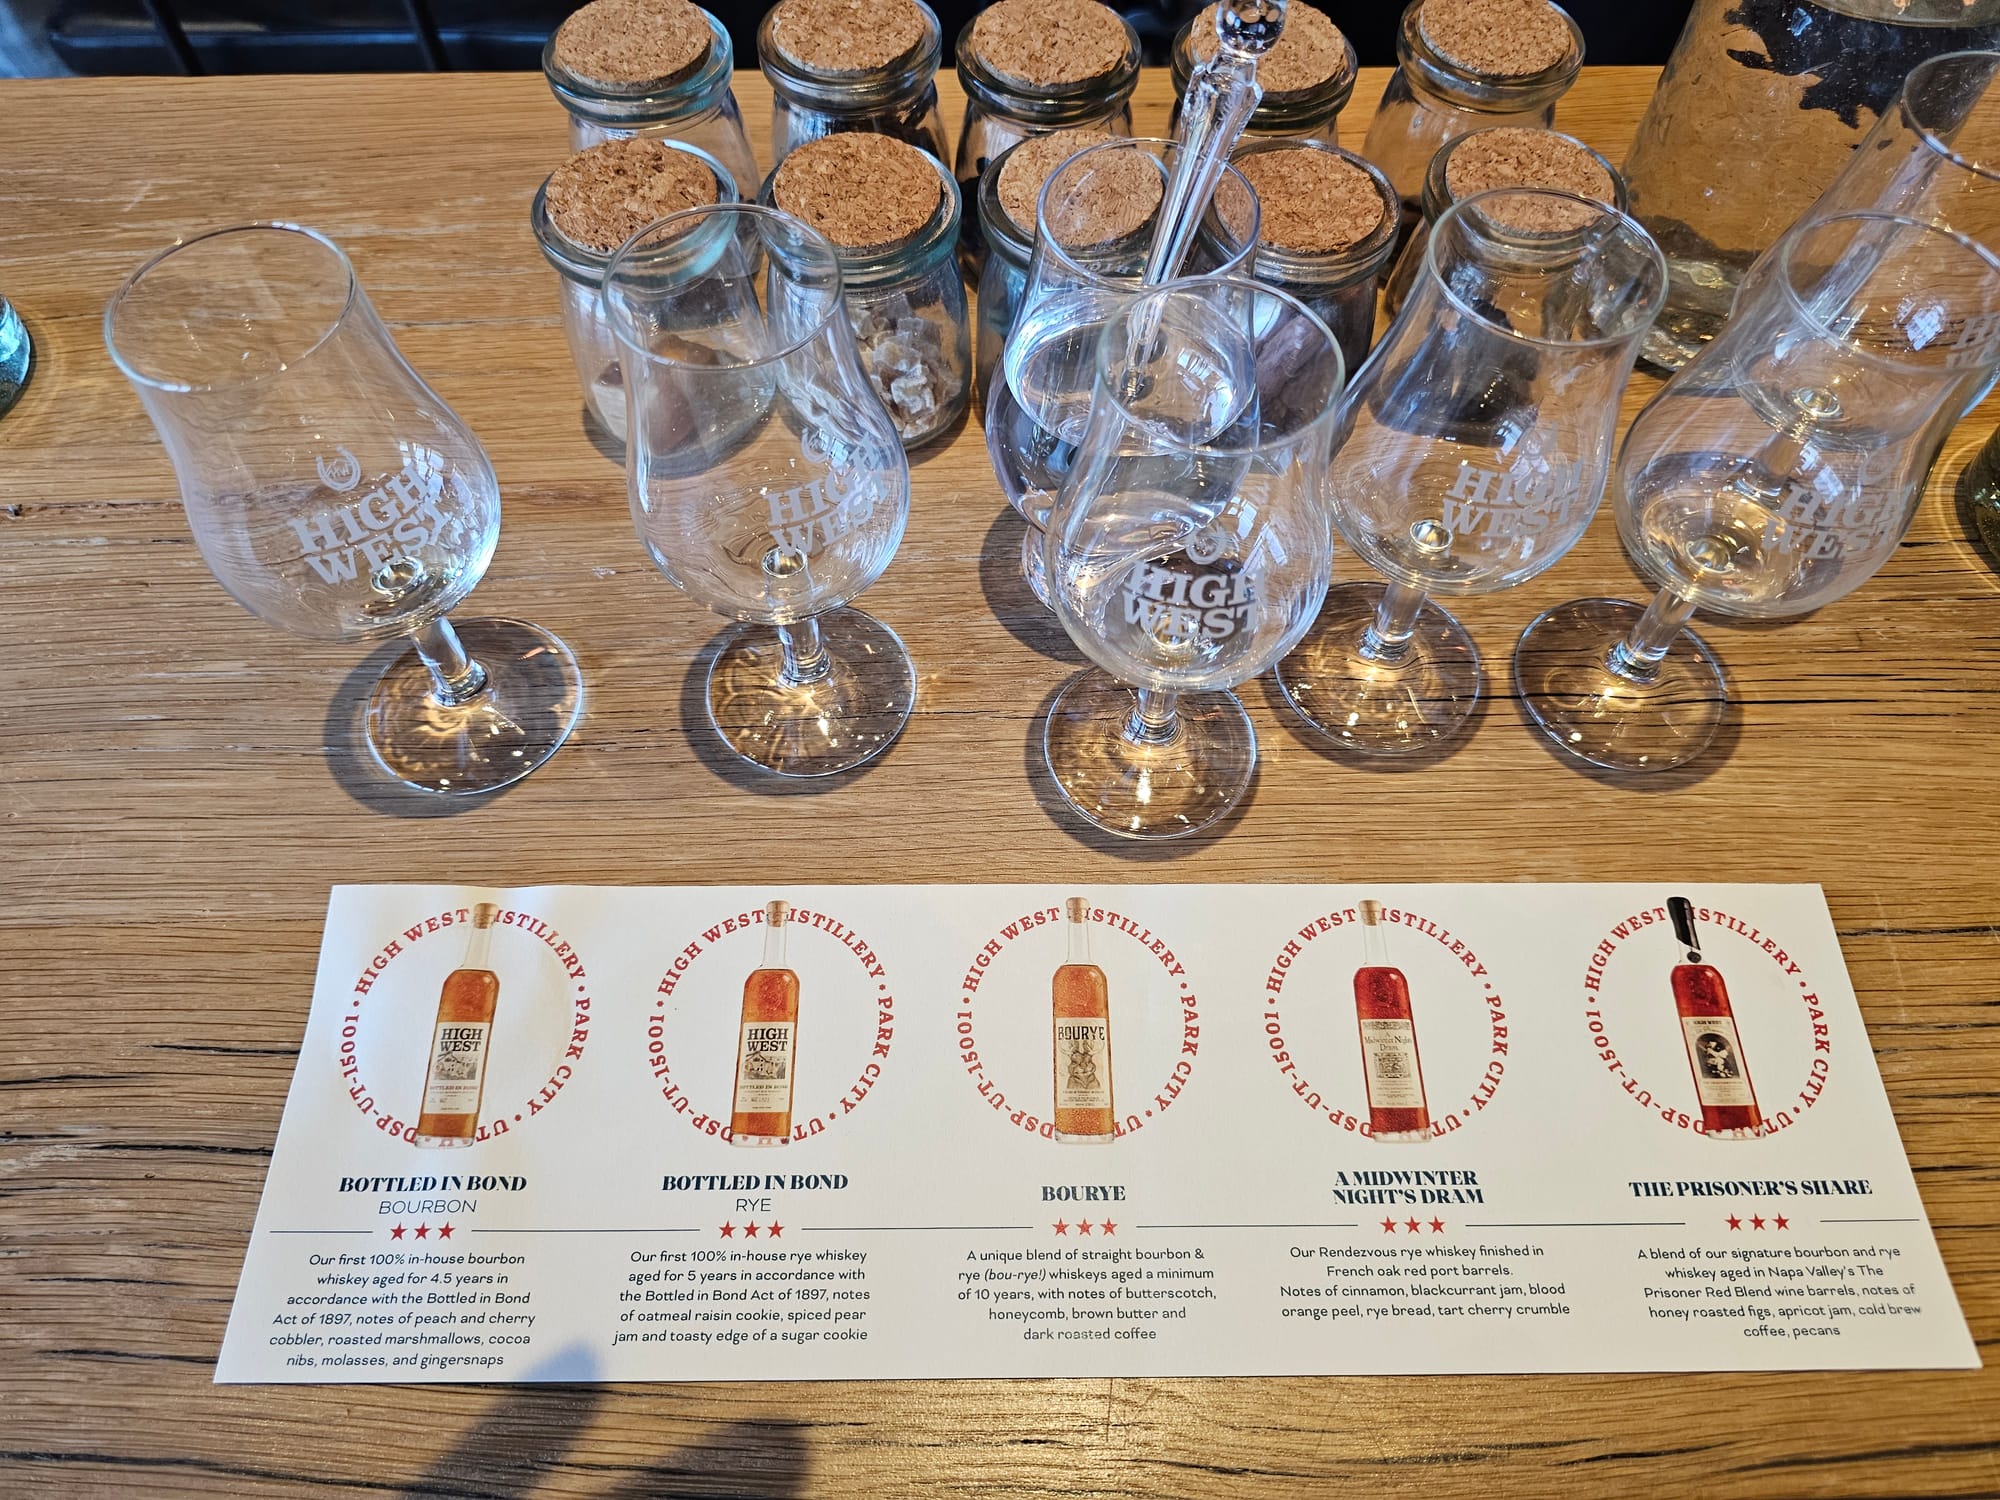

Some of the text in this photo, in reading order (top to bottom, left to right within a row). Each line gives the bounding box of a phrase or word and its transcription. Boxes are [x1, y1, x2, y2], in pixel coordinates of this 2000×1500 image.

[1446, 459, 1585, 507] HIGH
[287, 464, 430, 554] HIGH
[1442, 489, 1575, 538] WEST
[304, 496, 453, 585] WEST
[1125, 559, 1266, 609] HIGH
[1122, 590, 1258, 639] WEST
[354, 909, 469, 994] HIGH WEST
[658, 909, 765, 995] HIGH WEST
[963, 907, 1060, 992] HIGH WEST
[1266, 909, 1356, 993] HIGH WEST
[1584, 907, 1666, 991] HIGH WEST
[441, 1028, 484, 1041] HIGH
[747, 1027, 789, 1041] HIGH
[1058, 1025, 1105, 1041] BOURYE
[440, 1040, 482, 1052] WEST
[747, 1040, 788, 1052] WEST
[1155, 995, 1201, 1111] PARK CITY
[1472, 996, 1509, 1110] PARK CITY
[1800, 993, 1831, 1108] PARK CITY
[528, 998, 591, 1115] PARK CITY
[841, 997, 895, 1114] PARK CITY
[338, 1175, 527, 1192] BOTTLED IN BOND
[661, 1174, 848, 1191] BOTTLED IN BOND
[1335, 1170, 1479, 1186] A MIDWINTER
[1042, 1185, 1126, 1201] BOURYE
[1332, 1188, 1484, 1205] NIGHT'S DRAM
[1628, 1179, 1873, 1197] THE PRISONER'S SHARE
[378, 1199, 477, 1214] BOURBON
[736, 1198, 772, 1212] RYE
[309, 1252, 525, 1265] Our first 100% in-house bourbon
[630, 1249, 867, 1265] Our first 100% in-house rye whiskey
[966, 1247, 1205, 1264] A unique blend of straight bourbon &
[1290, 1244, 1544, 1261] Our Rendezvous rye whiskey finished in
[1638, 1245, 1901, 1262] A blend of our signature bourbon and rye
[628, 1268, 865, 1286] aged for 5 years in accordance with
[958, 1267, 1214, 1285] rye (bou-rye!) whiskeys aged a minimum
[1327, 1264, 1513, 1280] French oak red port barrels.
[1665, 1264, 1885, 1282] whiskey aged in Napa Valley's The
[287, 1291, 531, 1305] accordance with the Bottled in Bond
[1280, 1282, 1566, 1299] Notes of cinnamon, blackcurrant jam, blood
[620, 1308, 866, 1324] of oatmeal raisin cookie, spiced pear
[989, 1306, 1186, 1324] honeycomb, brown butter and
[1281, 1302, 1570, 1321] orange peel, rye bread, tart cherry crumble
[269, 1332, 530, 1347] cobbler, roasted marshmallows, cocoa
[1023, 1327, 1157, 1340] dark roasted coffee
[1743, 1324, 1841, 1340] coffee, pecans
[286, 1353, 504, 1370] nibs, molasses, and gingersnaps
